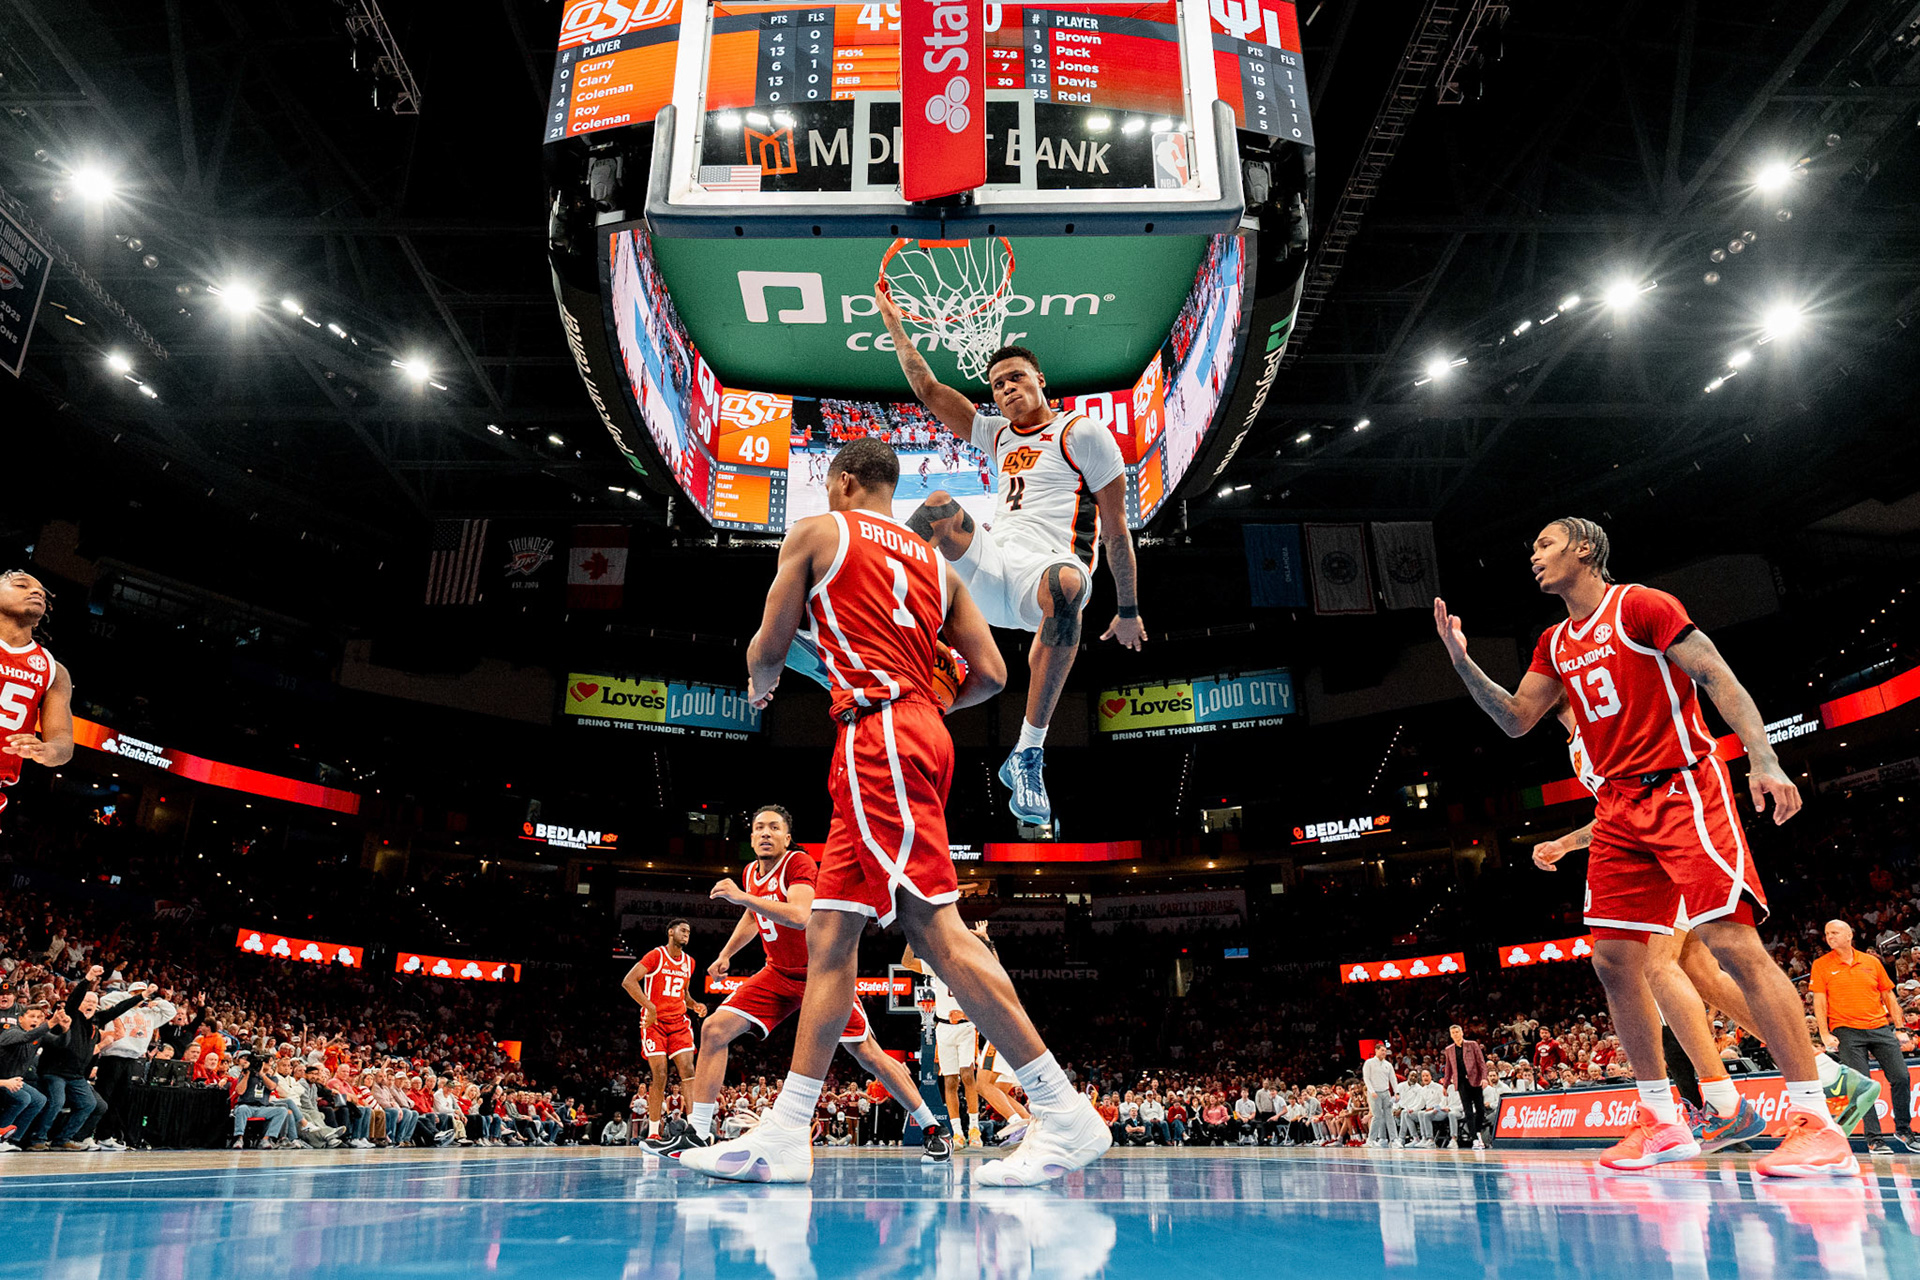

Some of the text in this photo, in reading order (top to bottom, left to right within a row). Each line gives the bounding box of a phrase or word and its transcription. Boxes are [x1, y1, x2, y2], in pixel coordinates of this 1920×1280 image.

[770, 13, 825, 25] PTS FLS
[1032, 14, 1099, 30] # PLAYER
[772, 29, 821, 43] 4 0
[923, 0, 969, 73] Sta
[1034, 29, 1102, 45] 1 Brown
[562, 40, 621, 64] # PLAYER
[769, 44, 820, 57] 13 2
[837, 49, 864, 57] FG%
[992, 50, 1018, 59] 37.8
[1033, 44, 1091, 58] 9 Pack
[1247, 46, 1296, 66] PTS FLS
[560, 59, 615, 79] 0 Curry
[771, 59, 818, 71] 6 1
[836, 63, 854, 71] TO
[1002, 63, 1010, 71] 7
[1030, 59, 1099, 74] 12 Jones
[1249, 62, 1292, 80] 10 1
[560, 73, 612, 93] 1 Clary
[768, 74, 819, 87] 13 0
[836, 76, 861, 85] REB
[997, 77, 1014, 86] 30
[1031, 74, 1097, 88] 13 Davis
[1251, 75, 1294, 94] 15 1
[556, 83, 634, 108] 4 Coleman
[769, 89, 818, 102] 0 0
[1033, 89, 1091, 103] 35 Reid
[1256, 90, 1296, 109] 9 1
[554, 105, 600, 123] 9 Roy
[1258, 105, 1298, 123] 2 1
[550, 113, 630, 139] 21 Coleman
[1260, 120, 1301, 138] 5 0
[1160, 178, 1177, 188] NBA
[0, 219, 43, 270] LAHOMA CITY
[697, 406, 711, 445] 50
[1144, 409, 1158, 445] 49
[738, 435, 770, 463] 49
[1001, 446, 1043, 475] OSU
[1006, 477, 1025, 511] 4
[507, 536, 554, 554] THUNDER
[858, 519, 929, 564] BROWN
[885, 555, 916, 629] 1
[1560, 645, 1616, 673] OKLAHOMA
[1198, 682, 1289, 717] LOUD CITY
[1570, 666, 1622, 723] 13
[670, 693, 758, 726] LOUD CITY
[577, 718, 748, 741] BRING THE THUNDER EXIT NOW
[1112, 718, 1283, 741] BRING THE THUNDER EXIT NOW
[1764, 713, 1803, 732] SENTED BY
[117, 733, 163, 754] PRESENTED BY
[535, 823, 601, 845] BEDLAM
[1305, 816, 1373, 838] BEDLAM
[548, 839, 587, 849] BASKETBALL
[1320, 832, 1360, 843] BASKETBALL
[1160, 902, 1189, 913] PARTY
[756, 912, 778, 942] 9
[1008, 968, 1100, 981] THUNDER
[662, 976, 684, 997] 12
